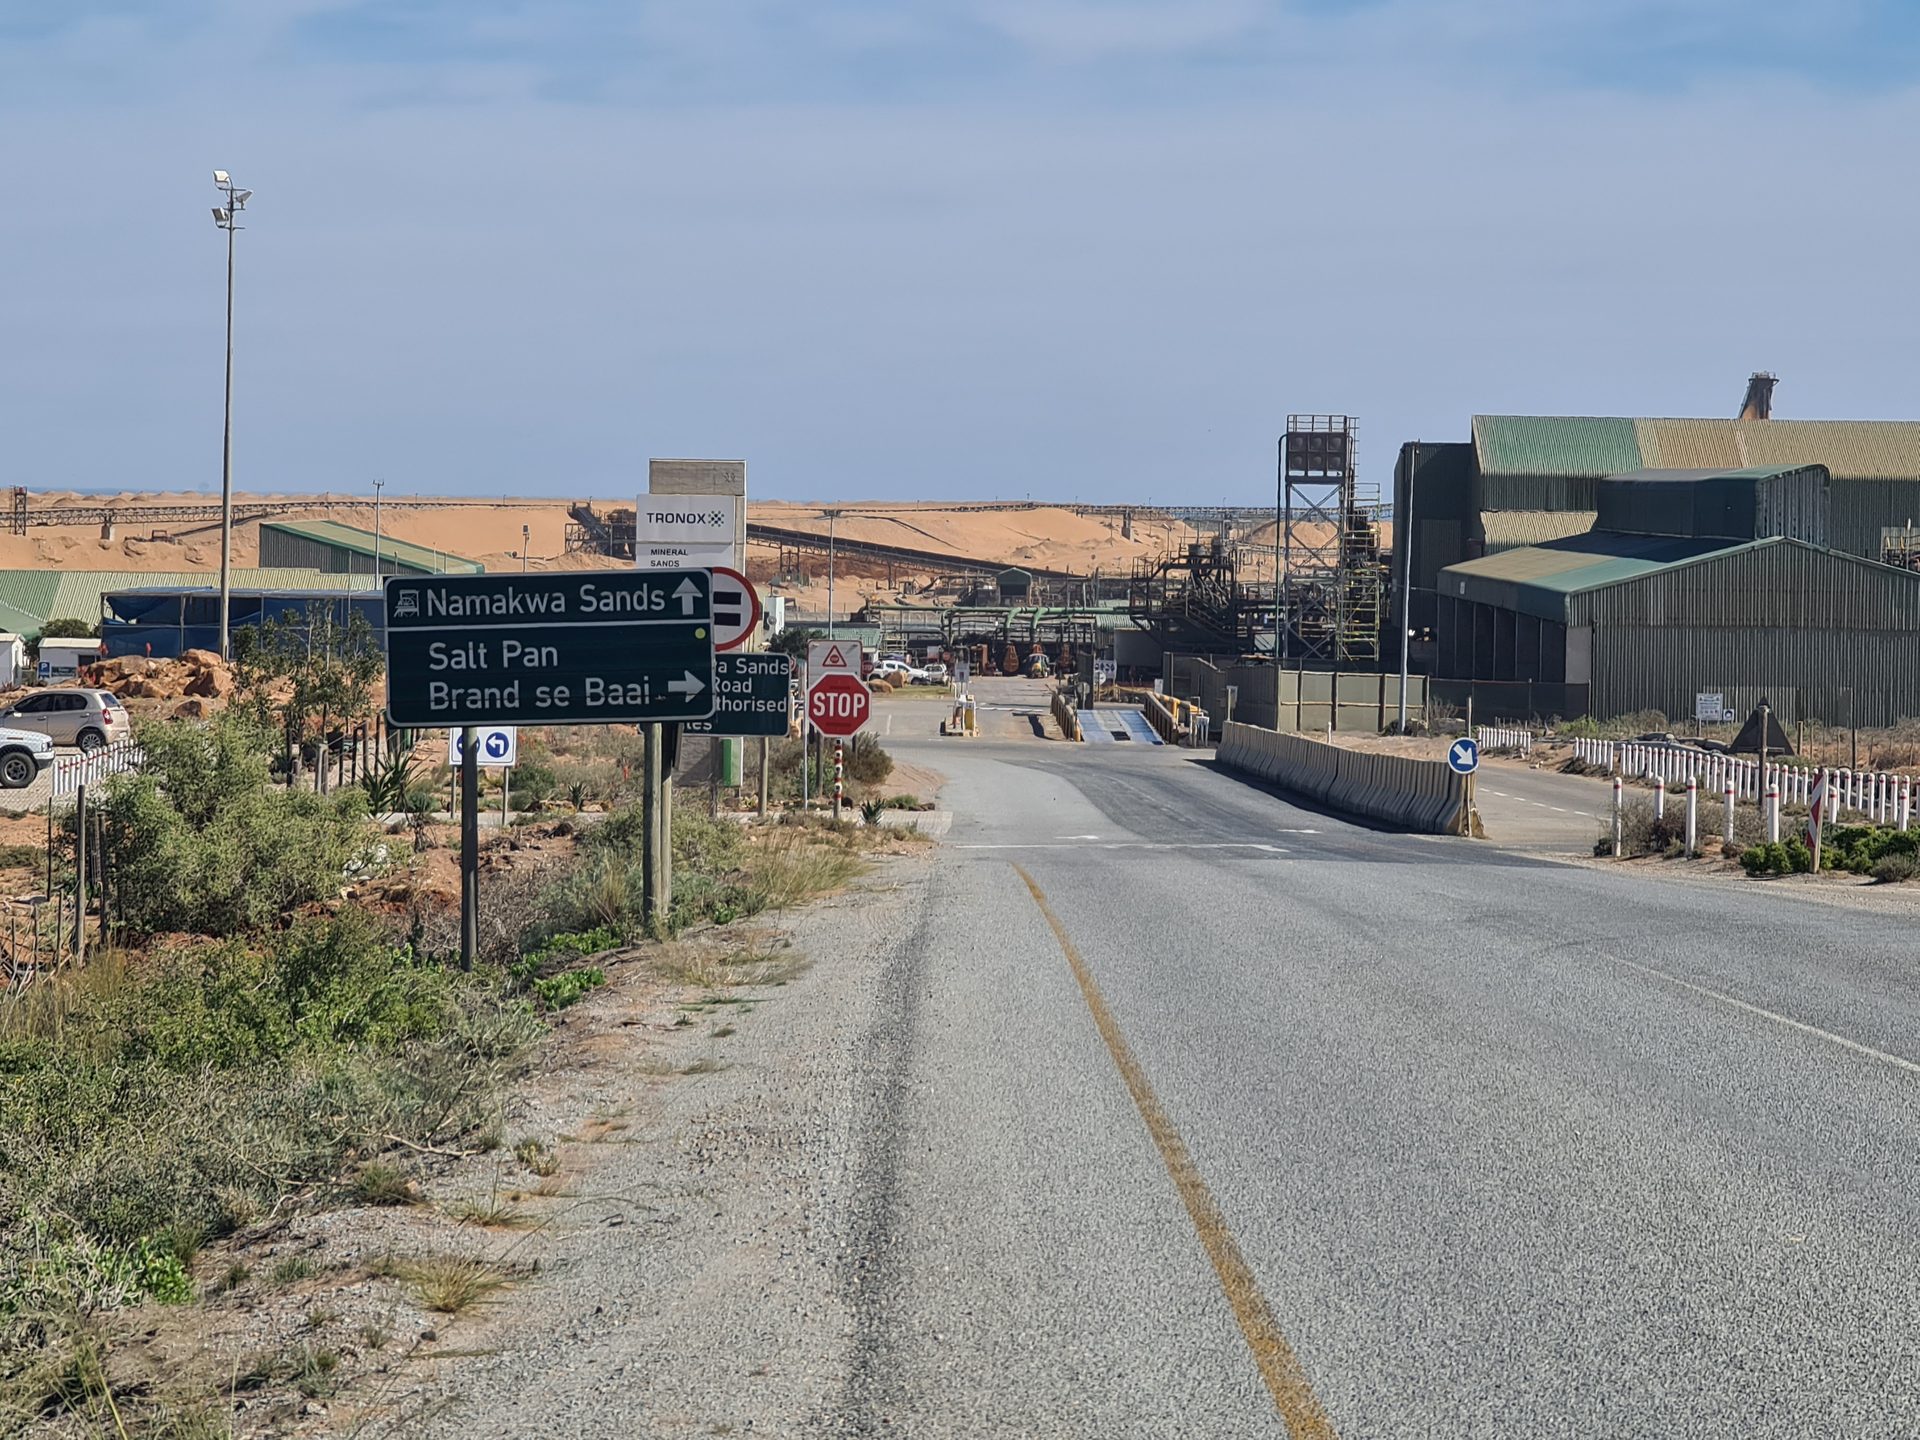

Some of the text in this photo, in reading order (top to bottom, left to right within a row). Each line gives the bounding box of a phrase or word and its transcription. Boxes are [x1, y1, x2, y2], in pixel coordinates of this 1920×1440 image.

[647, 513, 706, 524] TRONOX
[650, 548, 688, 556] MINERAL
[426, 583, 665, 616] Namakwa Sands
[429, 640, 558, 670] Salt Pan
[736, 658, 789, 675] Sands
[429, 676, 650, 710] Brand se Baai
[716, 695, 787, 712] thorised
[813, 692, 866, 718] STOP
